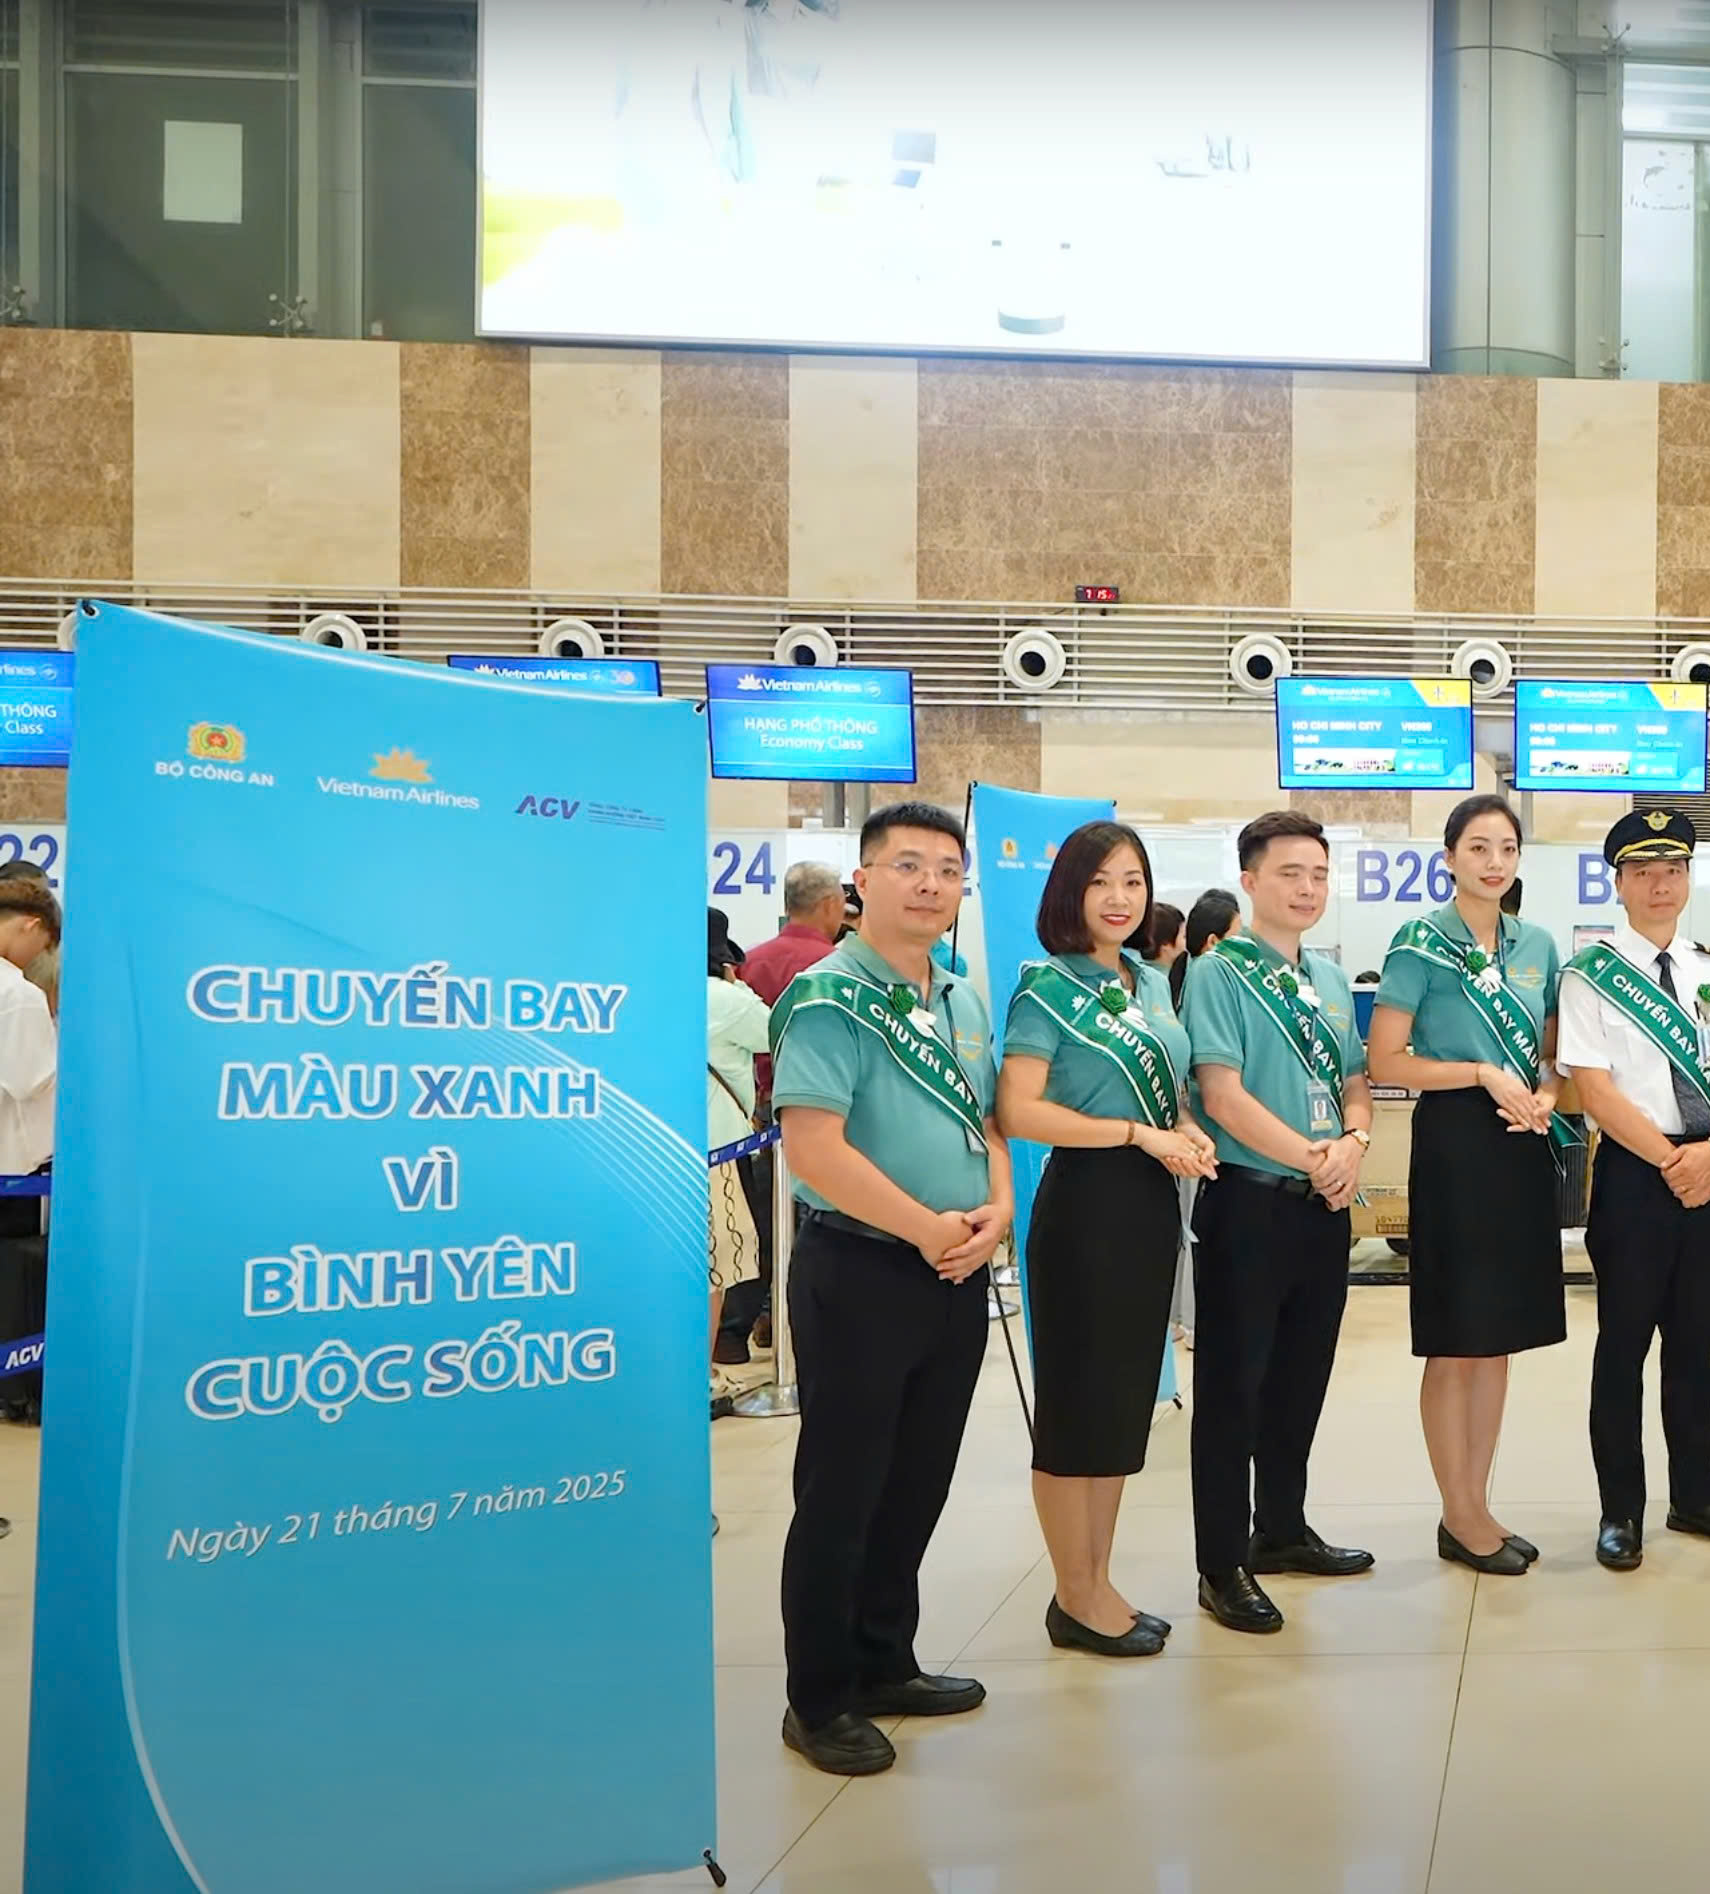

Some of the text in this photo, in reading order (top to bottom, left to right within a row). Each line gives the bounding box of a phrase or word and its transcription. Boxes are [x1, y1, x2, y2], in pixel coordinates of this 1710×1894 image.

[4, 720, 45, 735] Class
[743, 716, 788, 733] HẠNG
[825, 718, 878, 735] THÔNG
[760, 734, 864, 751] Economy Class
[154, 759, 275, 787] BỘ CÔNG AN
[514, 794, 581, 820] ACV
[712, 841, 776, 895] 24
[1356, 850, 1454, 903] B26
[187, 961, 628, 1033] CHUYẾN BAY
[1611, 973, 1673, 1029] CHUYẾN
[1668, 1024, 1697, 1056] BAY
[868, 1002, 941, 1075] CHUYẾN
[1094, 1012, 1158, 1080] CHUYẾN
[1312, 1039, 1336, 1072] BAY
[1511, 1030, 1540, 1069] MÀU
[217, 1053, 602, 1121] MÀU XANH
[383, 1146, 458, 1212] VÌ
[243, 1235, 577, 1317] BÌNH YÊN
[4, 1341, 45, 1370] ACV
[185, 1320, 616, 1423] CUỘC SỐNG
[166, 1469, 628, 1564] Ngày 21 tháng 7 năm 2025
